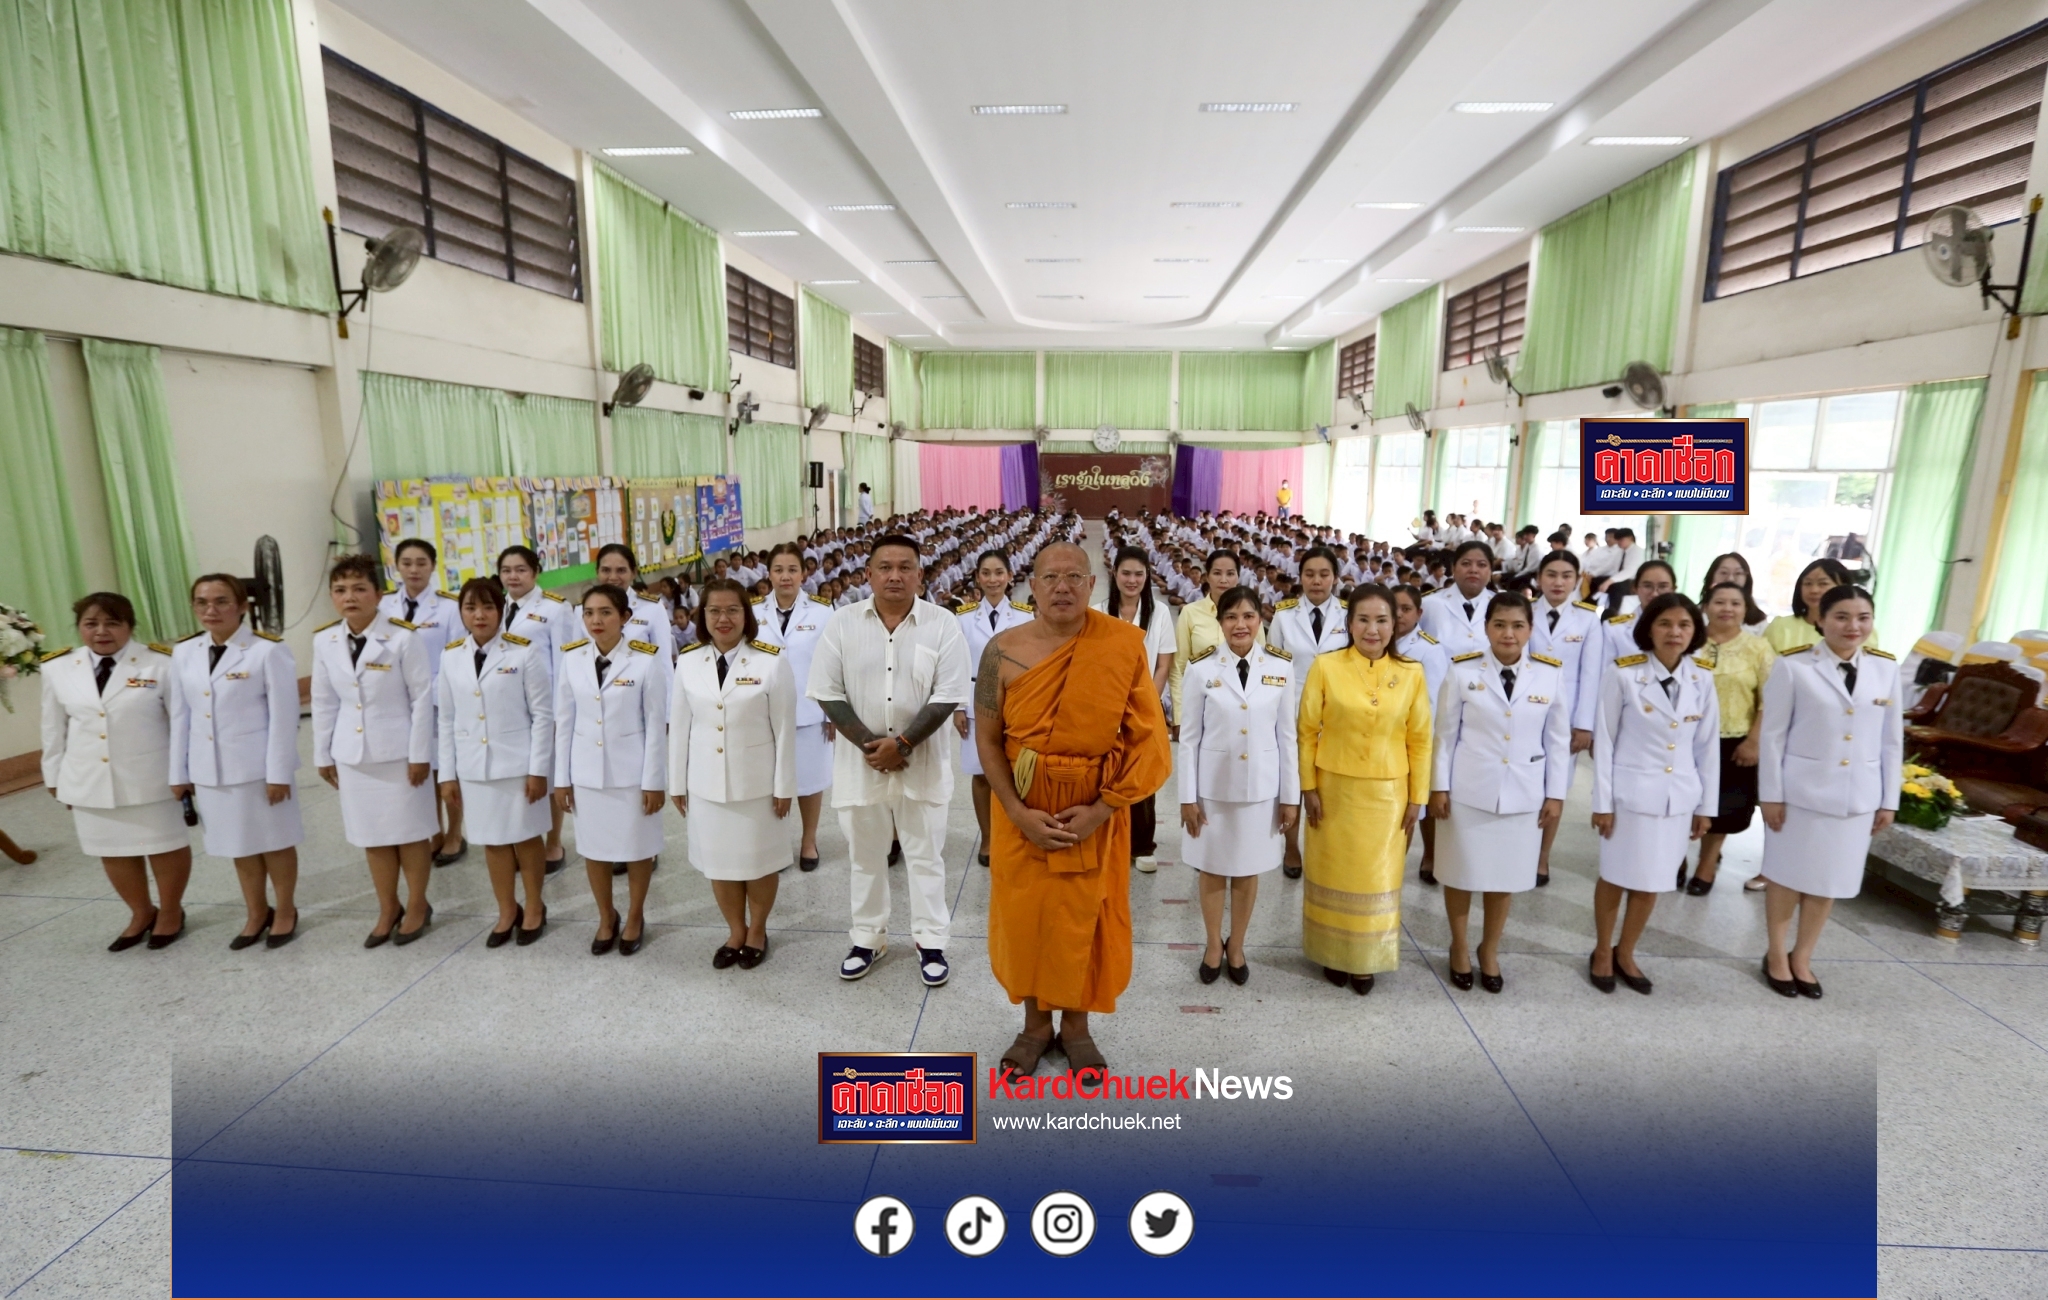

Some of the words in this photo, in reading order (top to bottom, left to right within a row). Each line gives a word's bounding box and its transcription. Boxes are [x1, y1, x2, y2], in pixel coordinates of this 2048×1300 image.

[1055, 465, 1151, 490] เรารักในหลวง
